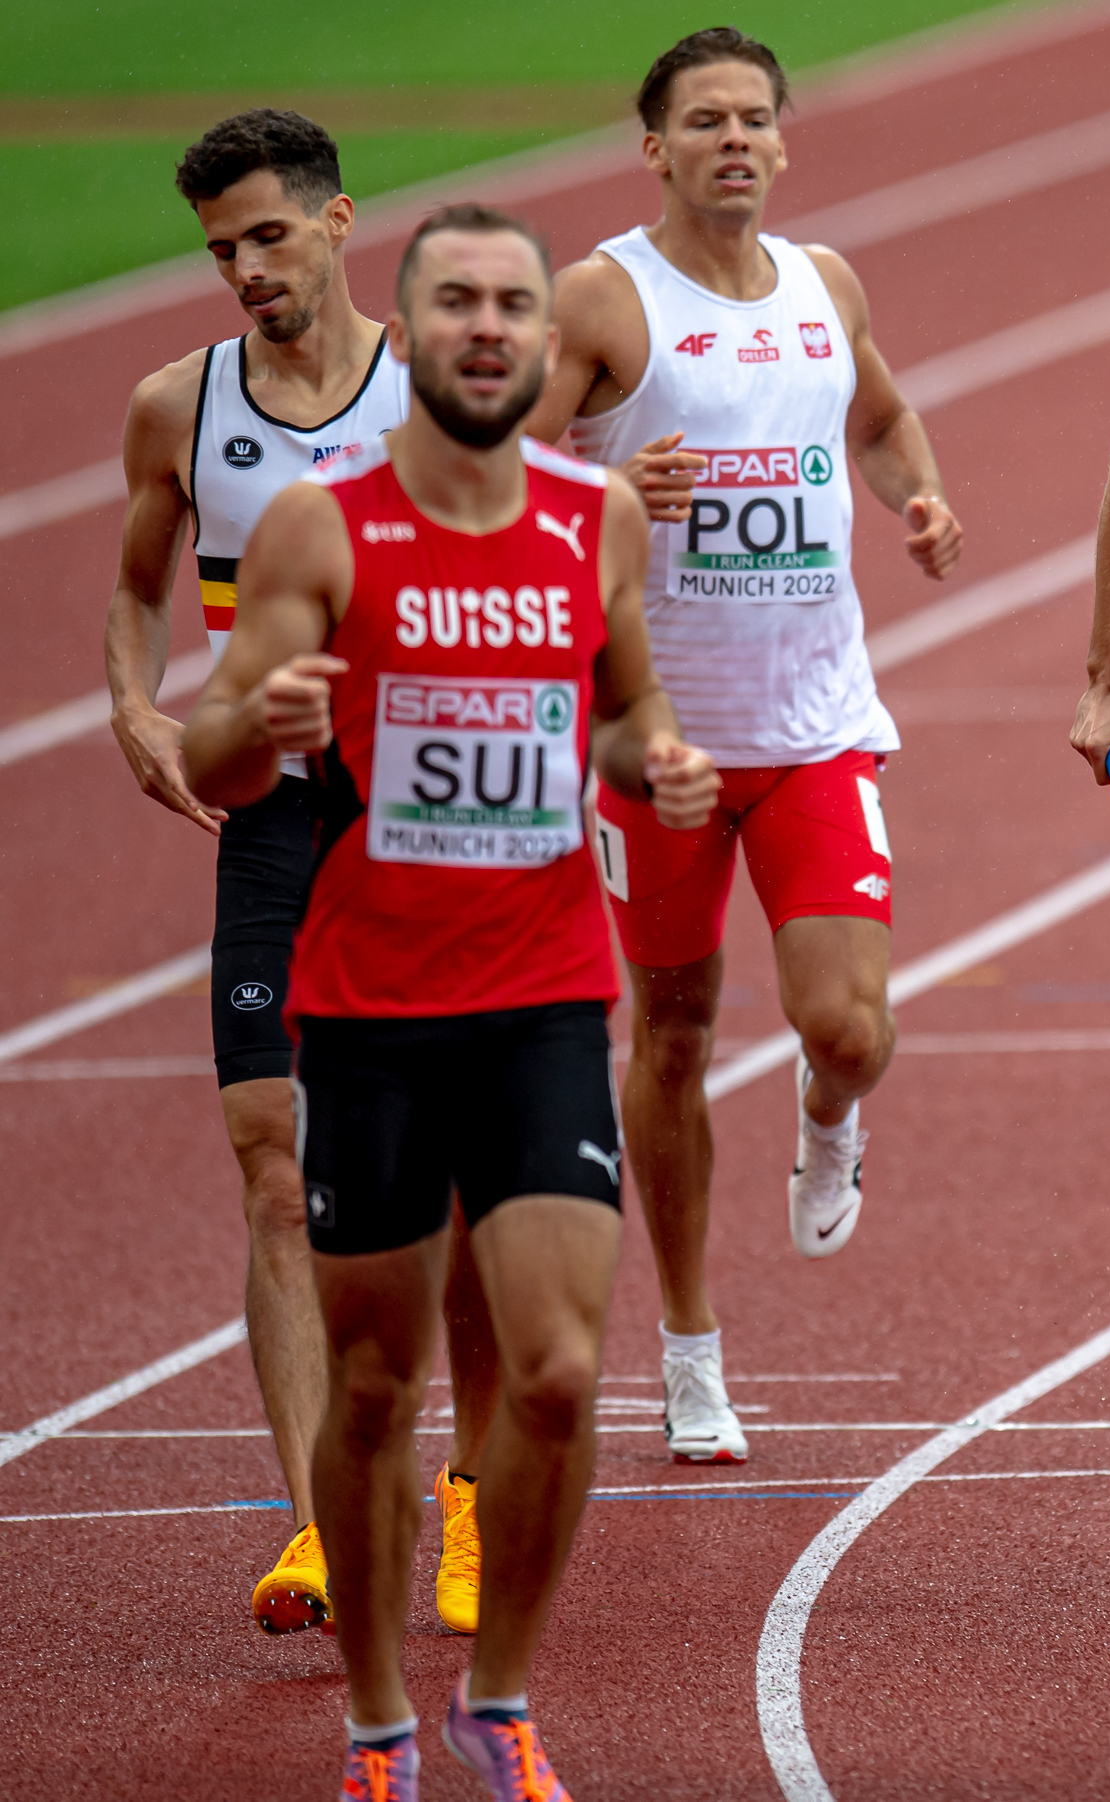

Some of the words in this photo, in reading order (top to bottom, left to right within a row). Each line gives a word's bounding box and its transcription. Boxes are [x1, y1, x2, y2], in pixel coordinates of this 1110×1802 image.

[675, 333, 718, 357] 4F
[740, 349, 777, 362] ORLEN
[228, 455, 257, 463] vermarc
[687, 497, 829, 555] POL
[721, 555, 754, 569] RUN
[680, 574, 775, 597] MUNICH
[783, 573, 836, 596] 2022
[388, 686, 530, 727] SPAR
[412, 742, 546, 809] SUI
[382, 826, 496, 859] MUNICH
[505, 832, 570, 860] 2022
[853, 873, 891, 901] 4F
[235, 998, 266, 1006] vermarc
